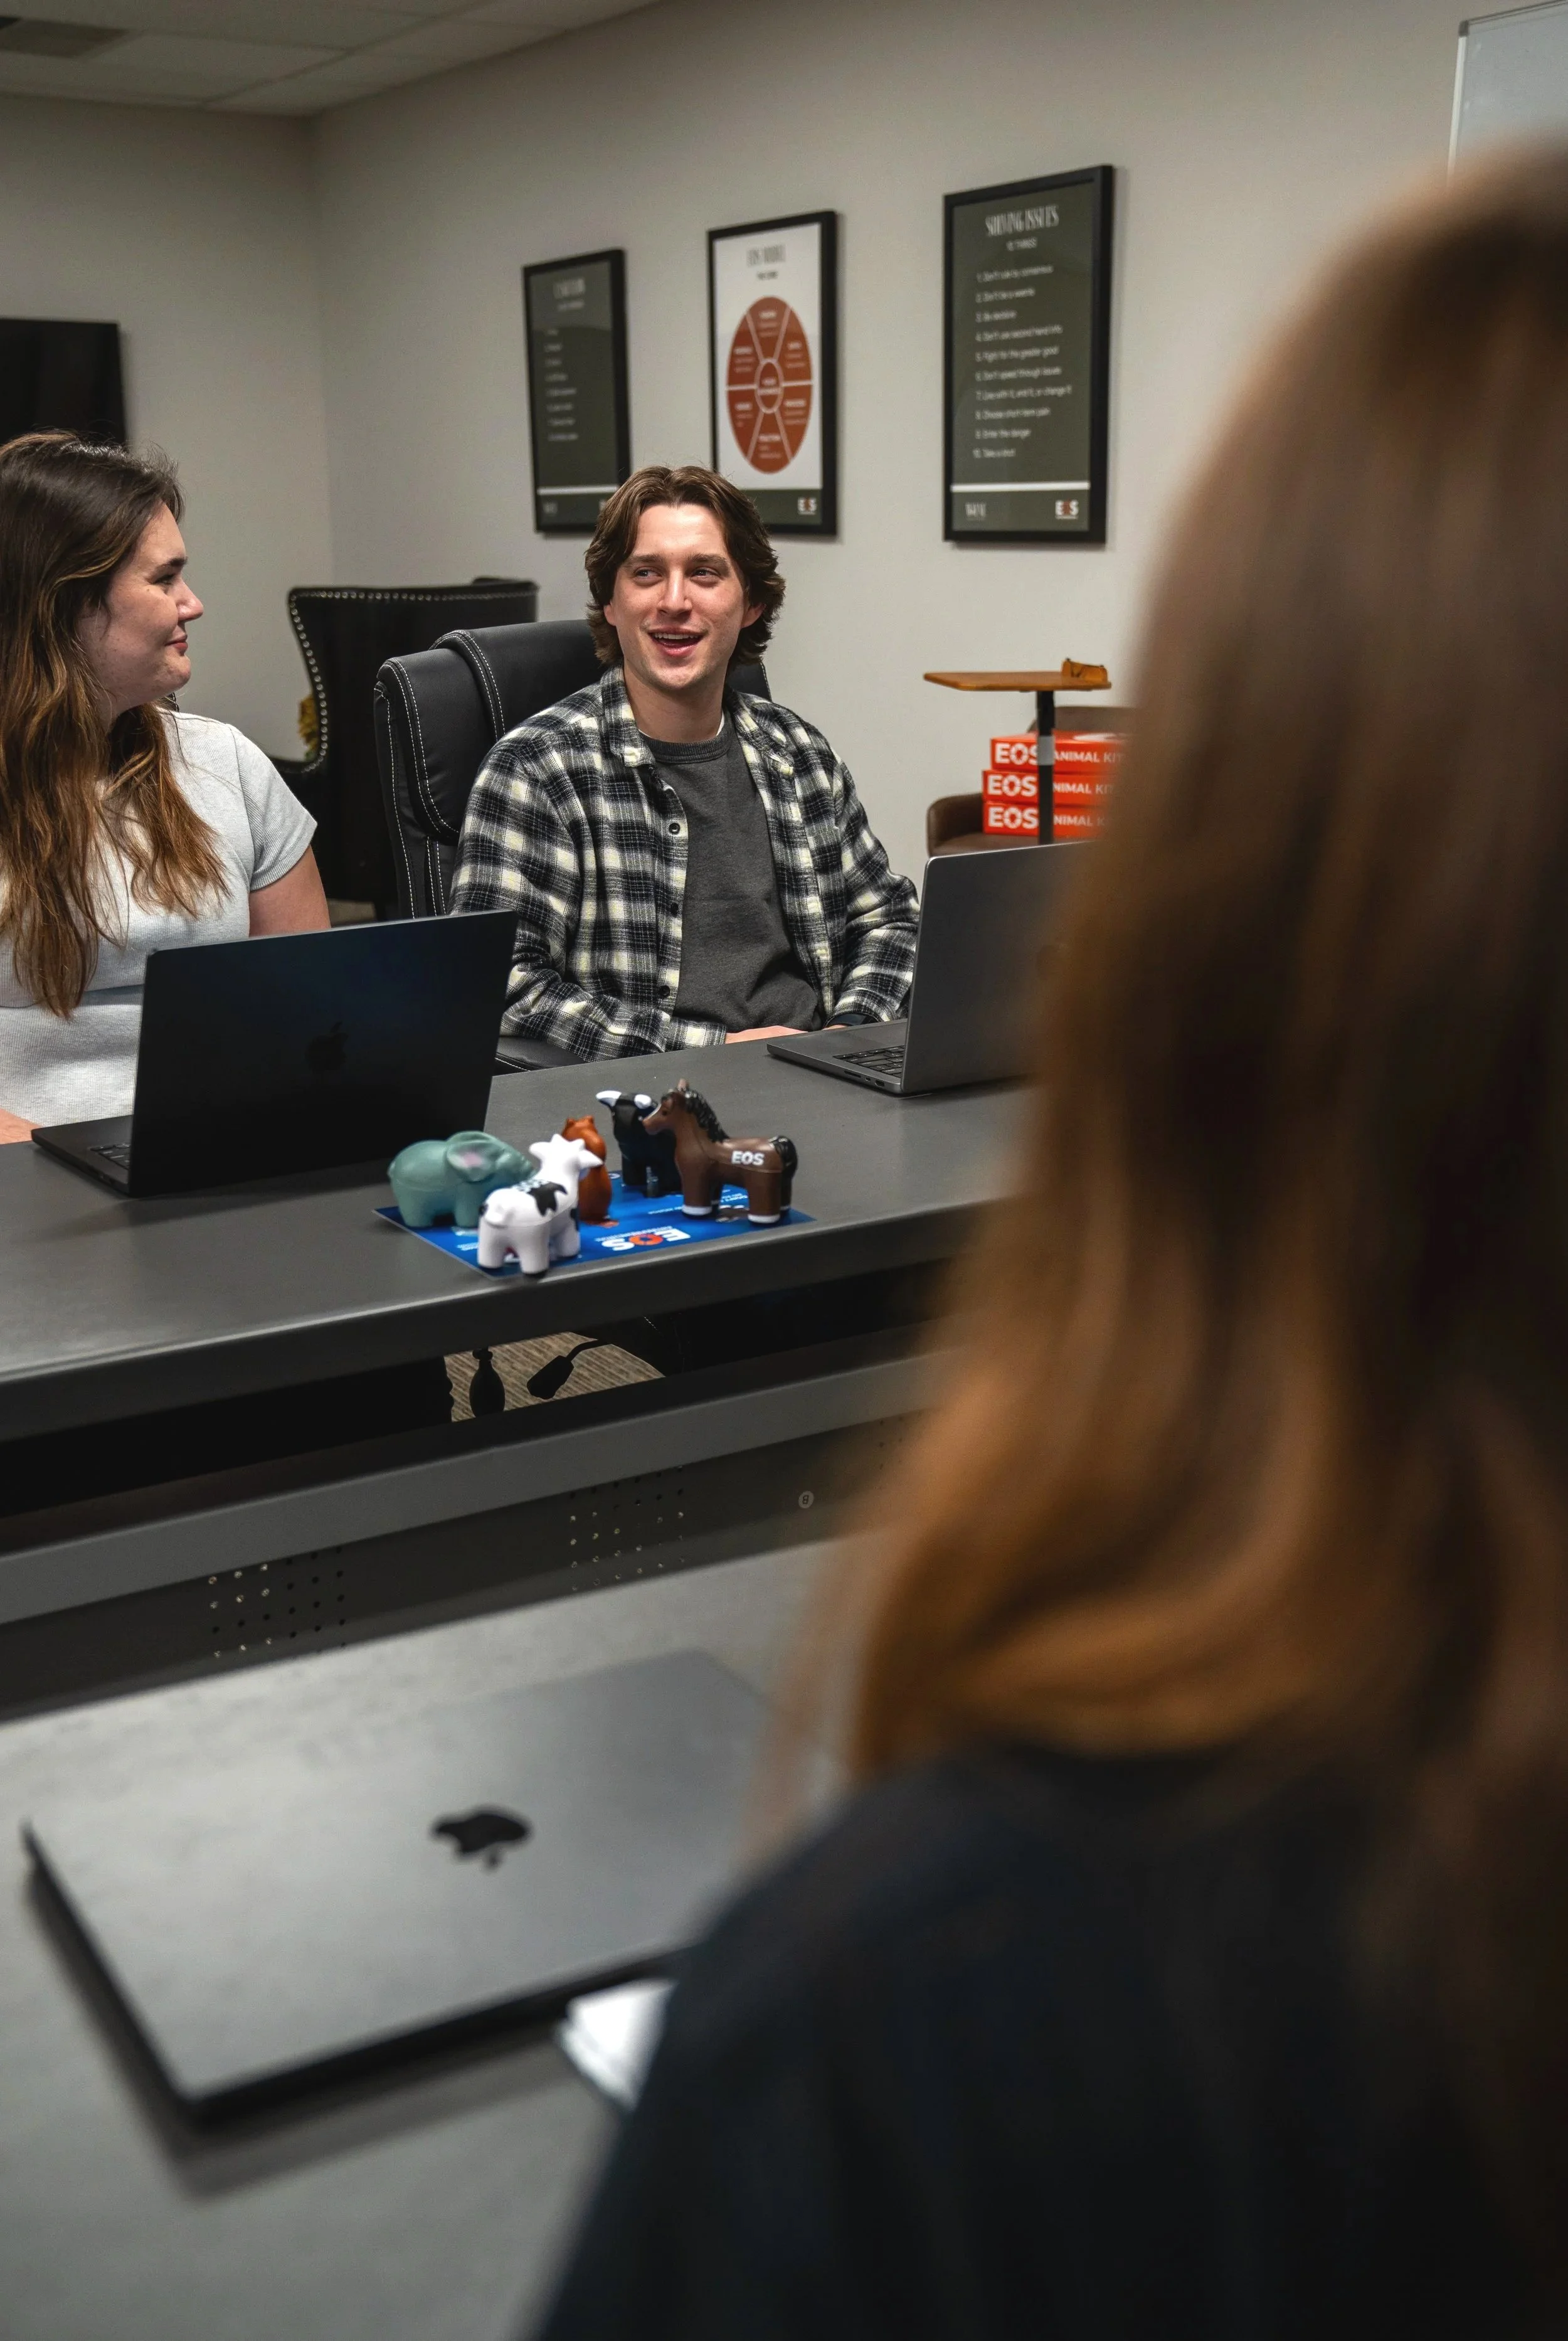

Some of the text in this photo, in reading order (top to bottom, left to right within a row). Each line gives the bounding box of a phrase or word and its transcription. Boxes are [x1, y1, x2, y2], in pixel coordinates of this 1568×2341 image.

[995, 742, 1039, 765] EOS
[987, 775, 1037, 797] EOS
[1053, 782, 1091, 794] NIMAL
[988, 807, 1039, 829] EOS
[1053, 815, 1093, 826] NIMAL
[731, 1150, 765, 1166] EOS
[601, 1228, 691, 1251] EOS
